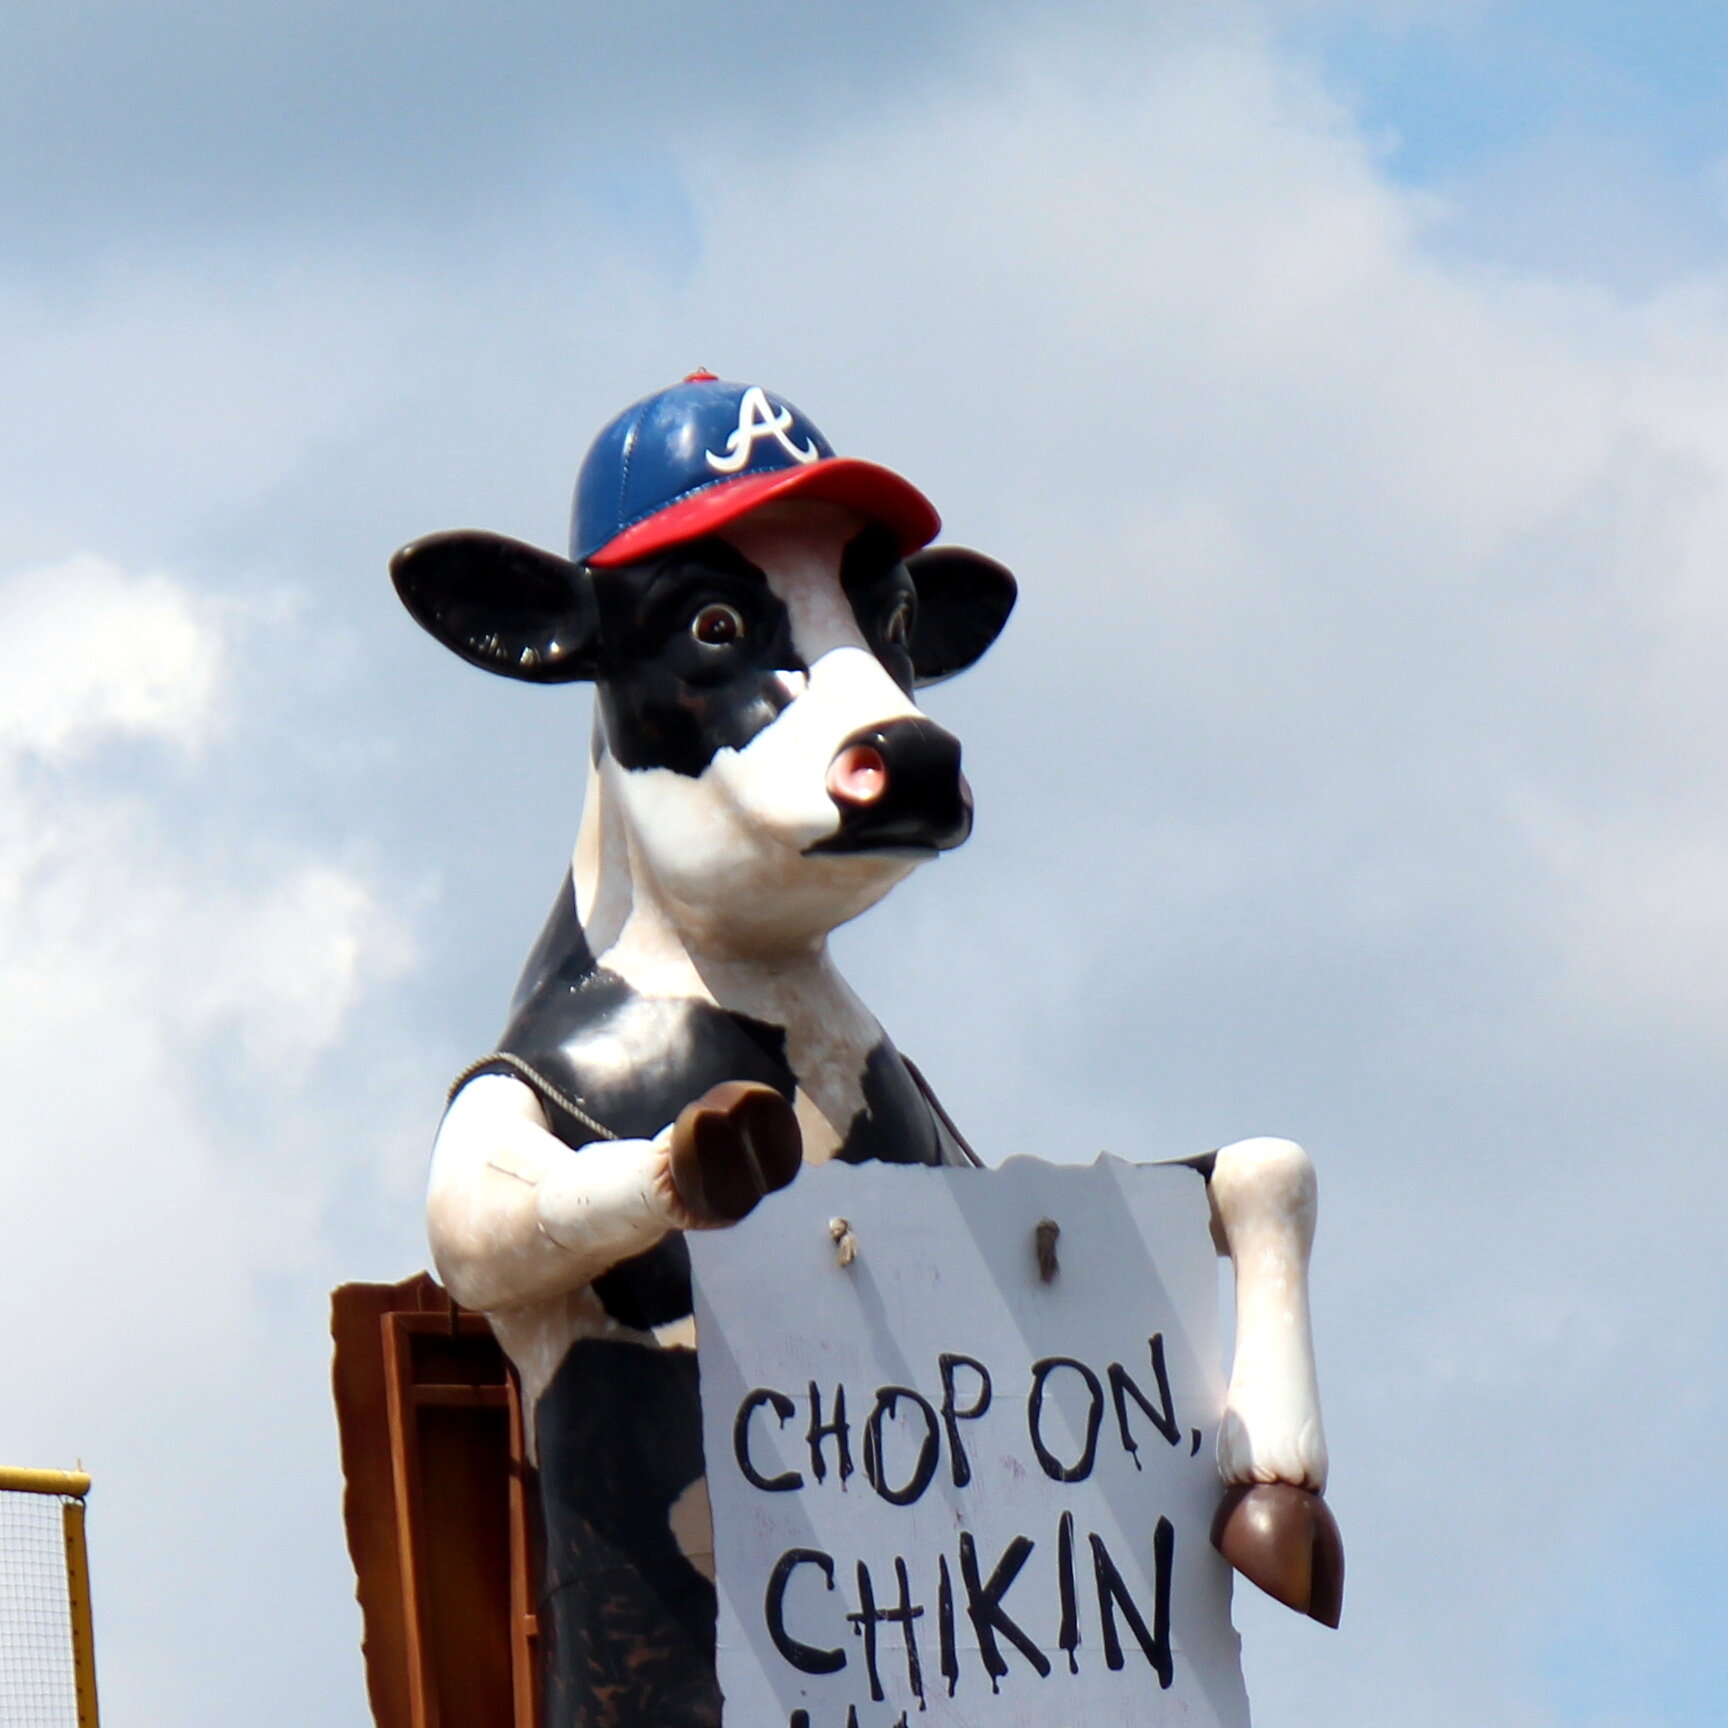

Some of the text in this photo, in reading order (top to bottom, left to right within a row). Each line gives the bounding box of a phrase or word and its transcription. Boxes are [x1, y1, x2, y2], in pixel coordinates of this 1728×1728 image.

[705, 386, 818, 472] A
[733, 1332, 1203, 1506] CHOP ON,
[764, 1510, 1175, 1711] CHIKIN
